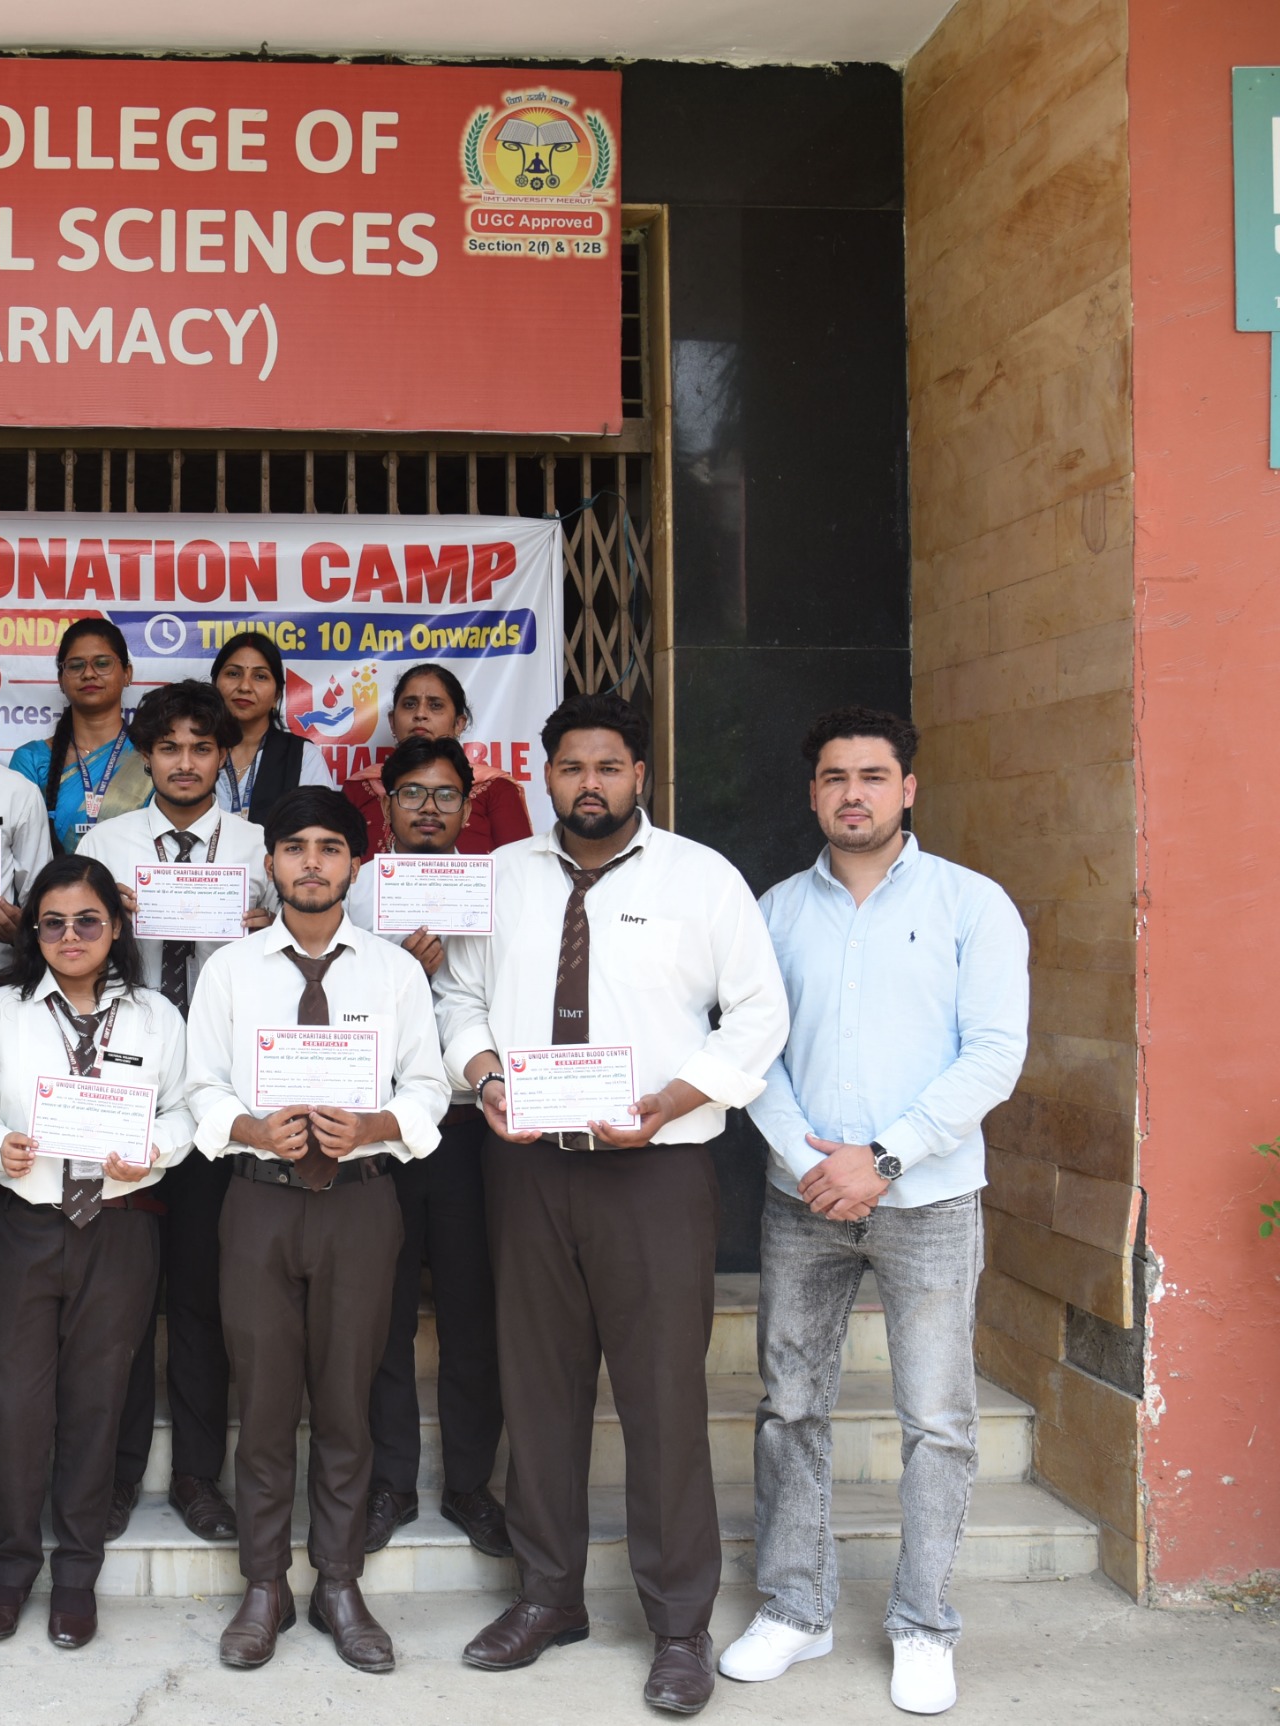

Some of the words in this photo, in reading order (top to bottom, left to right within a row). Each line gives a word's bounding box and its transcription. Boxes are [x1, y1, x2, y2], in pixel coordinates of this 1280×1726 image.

[296, 110, 400, 176] OF
[503, 196, 555, 204] UNIVERSITY
[477, 213, 515, 227] UGC
[519, 214, 593, 230] Approved
[58, 207, 440, 278] SCIENCES
[468, 239, 522, 251] Section
[528, 240, 550, 255] 2(f)
[555, 242, 566, 253] &
[574, 242, 602, 254] 12B
[302, 541, 518, 605] CAMP
[198, 620, 307, 651] TIMING:
[318, 621, 351, 652] 10
[360, 622, 405, 652] Am
[410, 620, 522, 652] Onwards
[621, 913, 647, 924] IIMT
[343, 1014, 369, 1022] IIMT
[559, 1009, 583, 1018] IIMT
